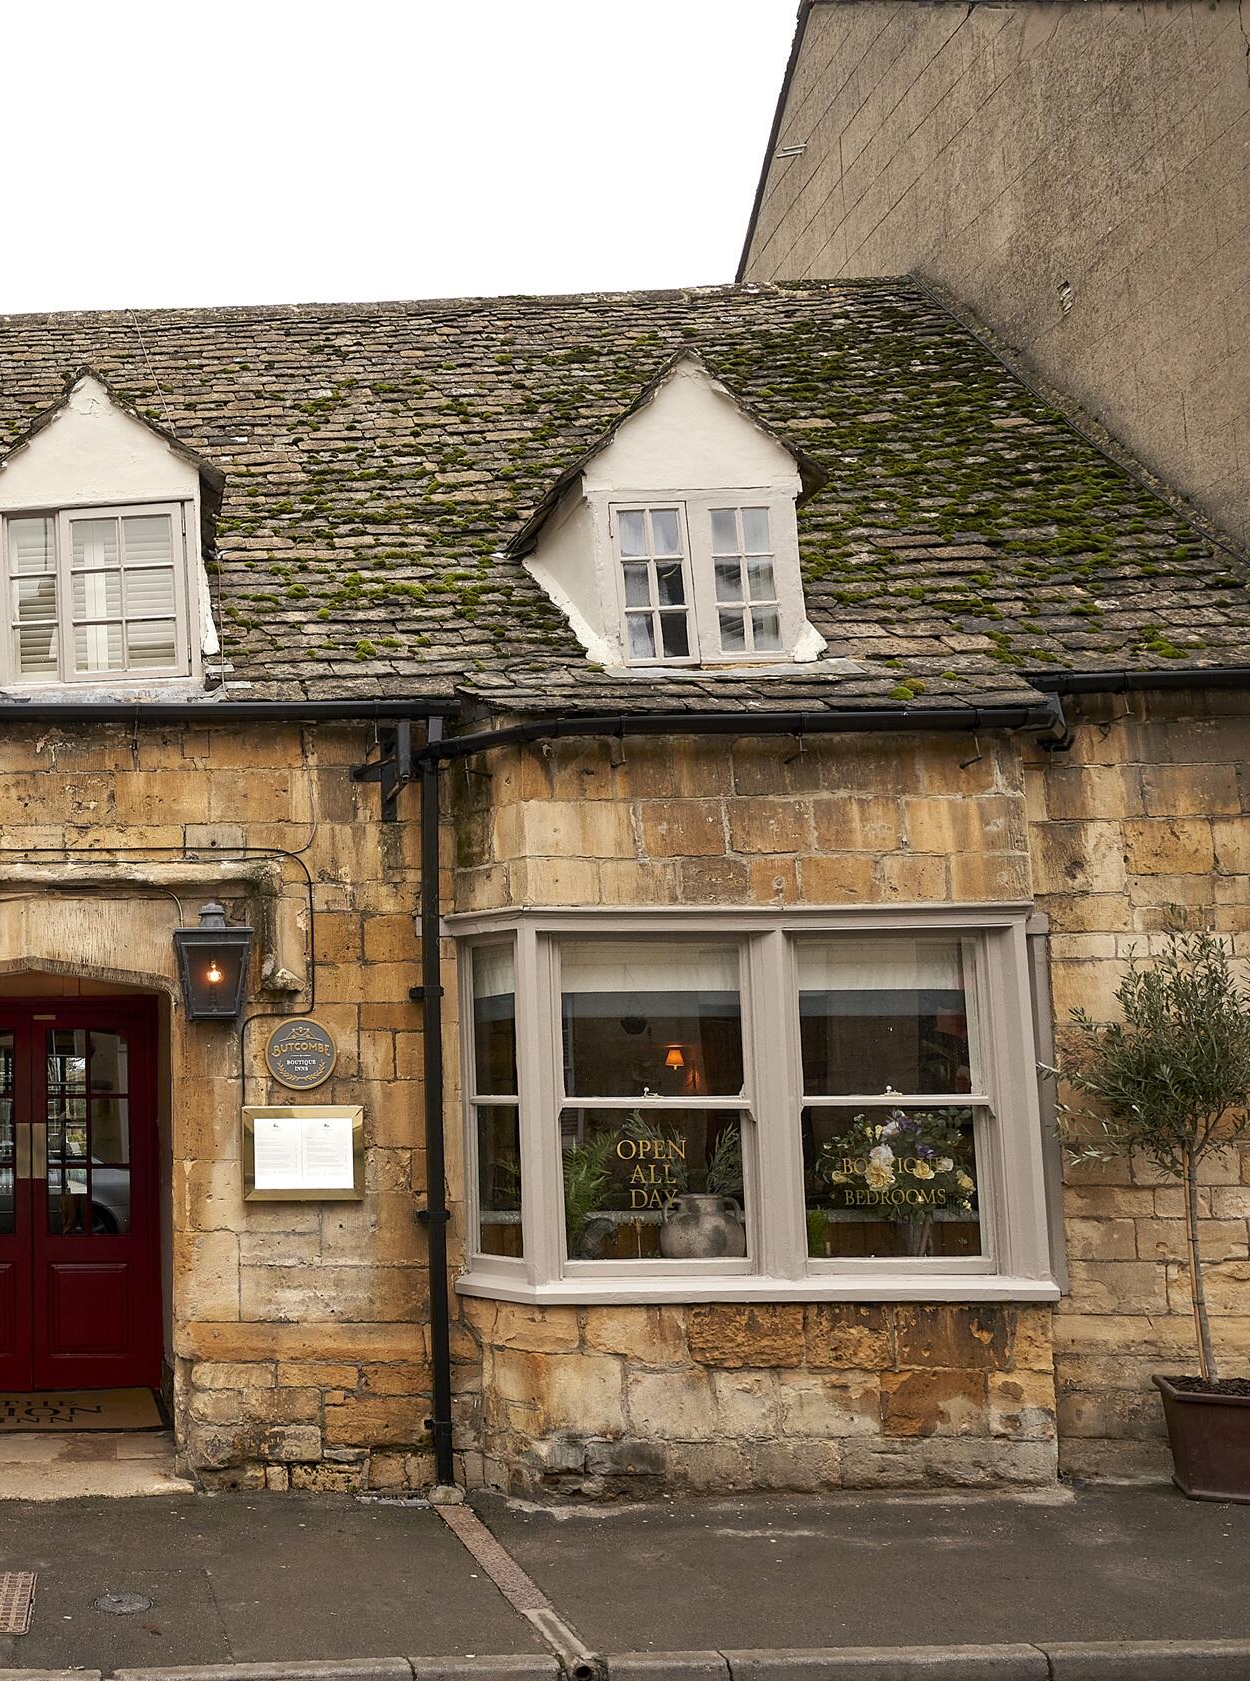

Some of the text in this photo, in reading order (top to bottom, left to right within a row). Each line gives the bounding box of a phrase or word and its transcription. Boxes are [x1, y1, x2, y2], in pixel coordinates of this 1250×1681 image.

[271, 1042, 331, 1057] BUTCOMBE
[616, 1139, 686, 1160] OPEN
[630, 1164, 676, 1184] ALL
[630, 1189, 678, 1209] DAY
[844, 1188, 946, 1205] BEDROOMS
[0, 1416, 74, 1424] INN
